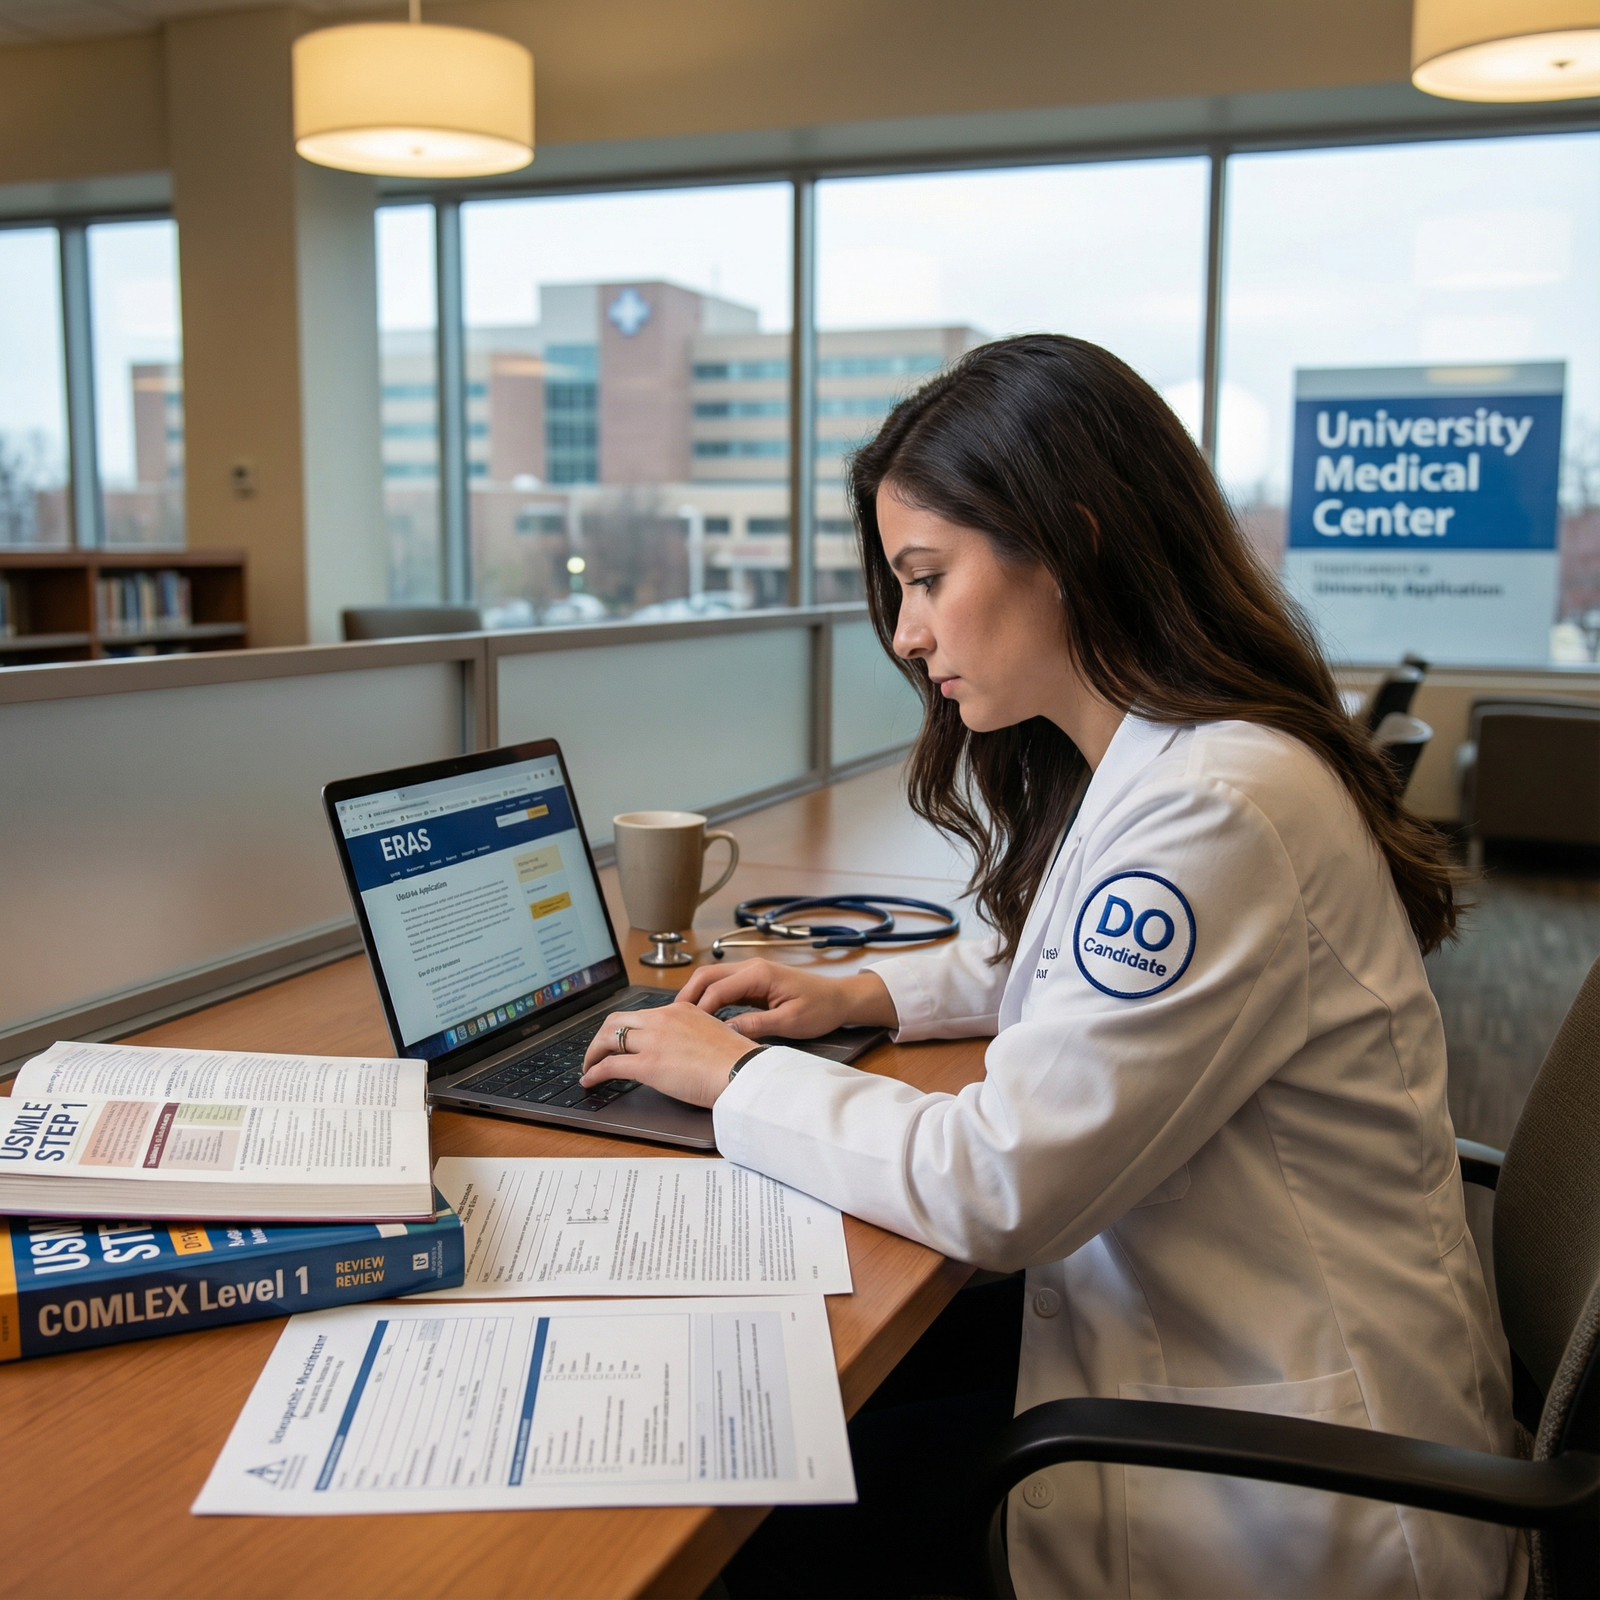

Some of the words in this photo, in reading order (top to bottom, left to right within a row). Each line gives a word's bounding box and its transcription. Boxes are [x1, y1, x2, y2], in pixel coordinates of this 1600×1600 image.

[1316, 407, 1534, 456] University
[1314, 452, 1480, 492] Medical
[1312, 498, 1456, 537] Center
[379, 827, 432, 862] ERAS
[1096, 894, 1175, 952] DO
[1083, 937, 1167, 977] Candidate
[0, 1102, 53, 1160] USMLE
[34, 1113, 80, 1161] STEP
[335, 1255, 385, 1274] REVIEW
[335, 1270, 385, 1289] REVIEW
[37, 1283, 190, 1337] COMLEX
[199, 1268, 284, 1312] Level
[295, 1265, 309, 1296] 1
